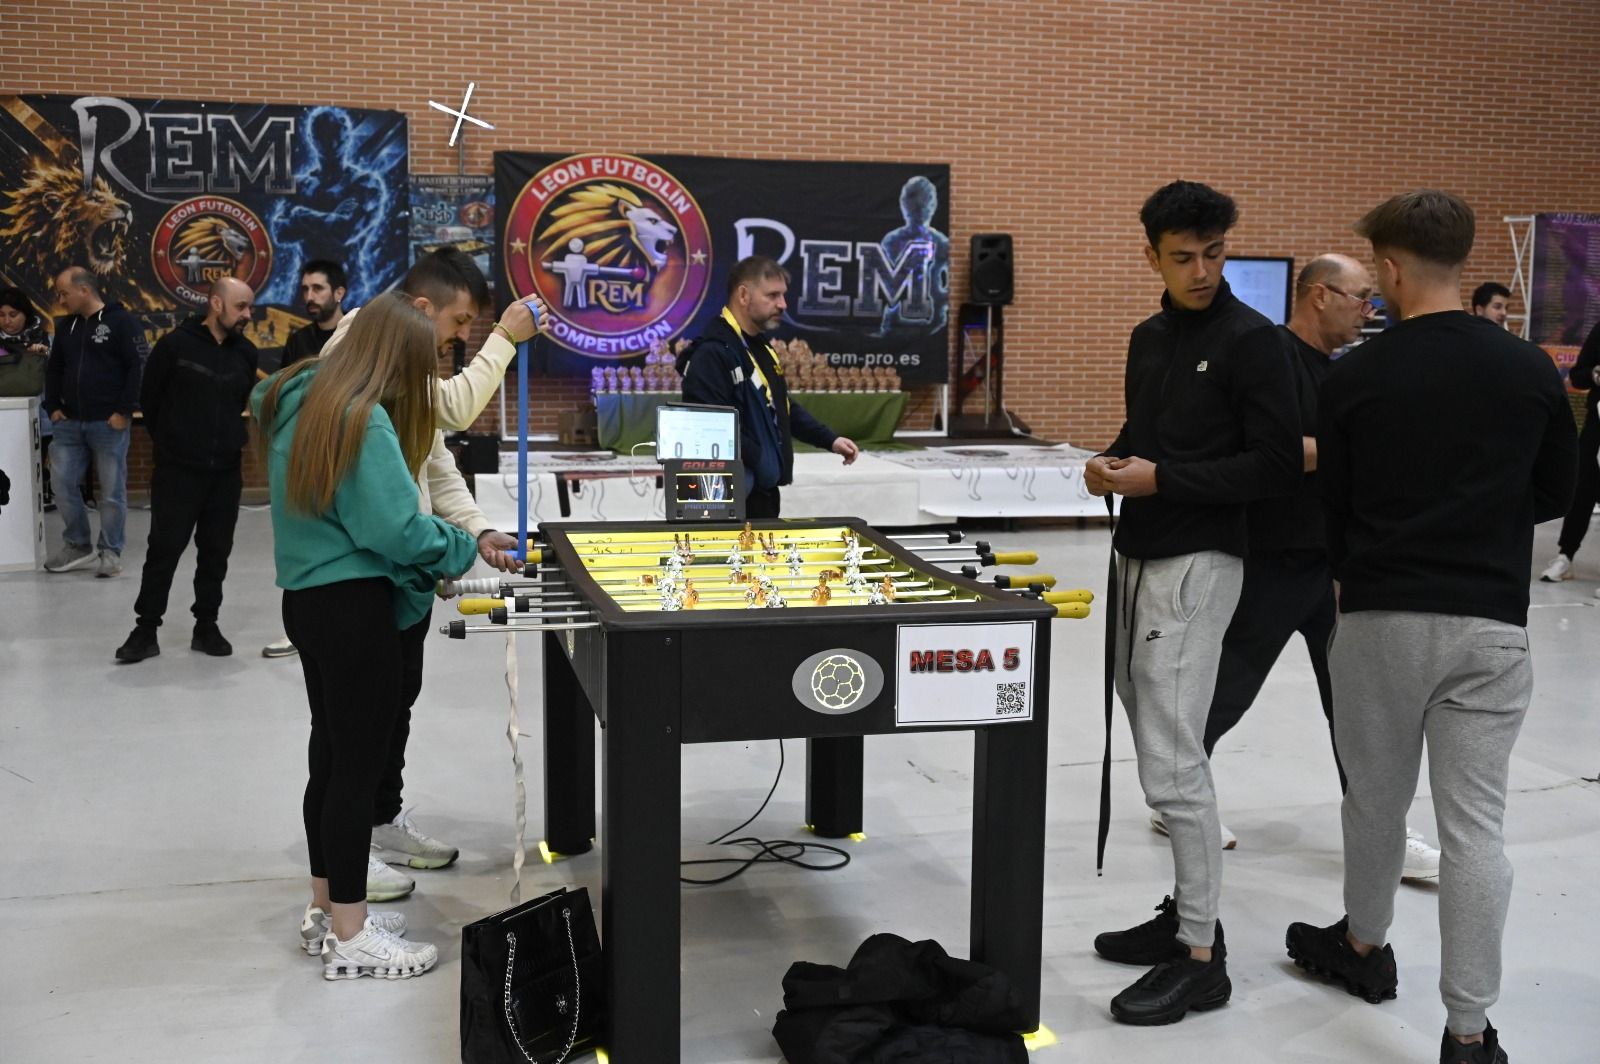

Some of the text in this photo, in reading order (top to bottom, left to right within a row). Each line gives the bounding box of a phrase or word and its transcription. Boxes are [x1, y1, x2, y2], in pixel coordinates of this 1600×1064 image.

[71, 96, 296, 203] REM
[531, 161, 585, 201] LEON
[166, 204, 197, 230] LEON
[202, 267, 232, 283] REM
[175, 286, 208, 303] COMP
[588, 279, 644, 312] REM
[910, 647, 1021, 673] MESA 5
